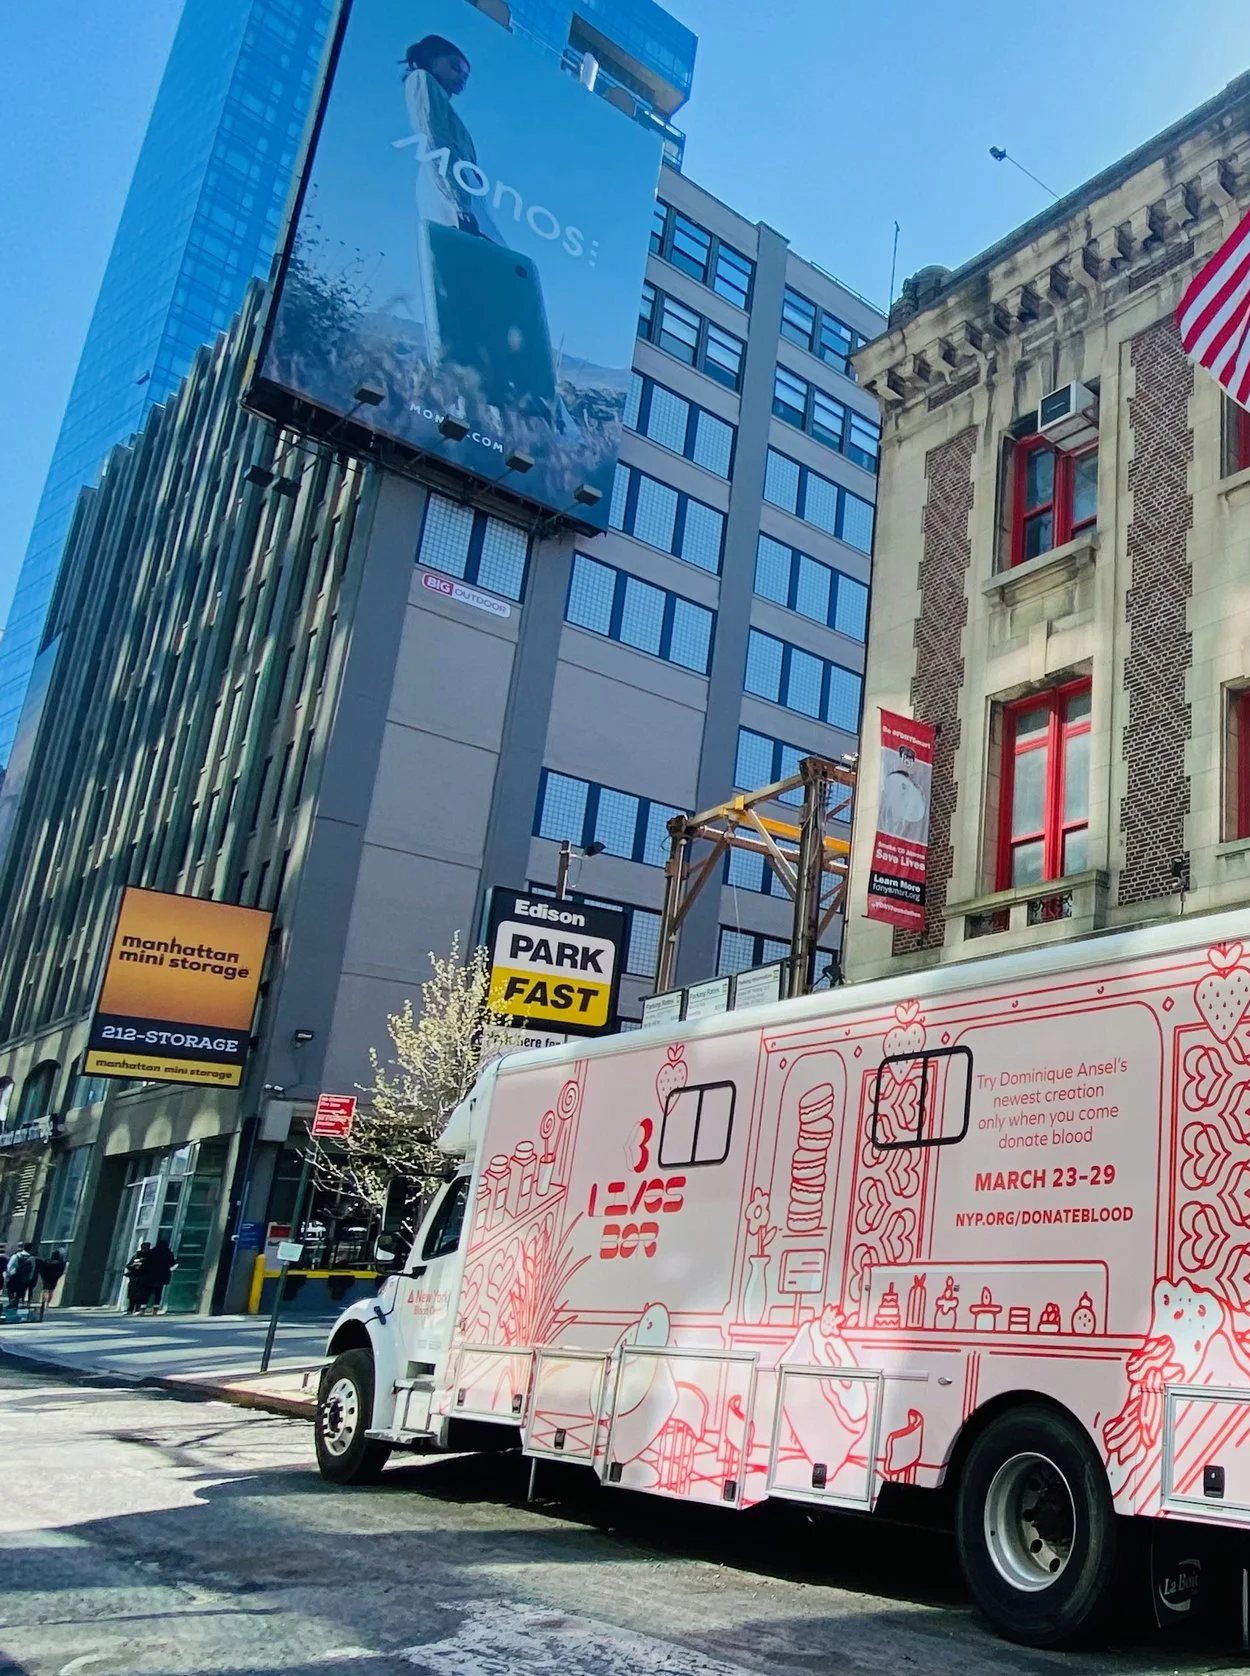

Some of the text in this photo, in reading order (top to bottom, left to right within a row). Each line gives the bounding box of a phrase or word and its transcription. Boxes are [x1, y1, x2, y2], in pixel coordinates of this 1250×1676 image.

[410, 403, 504, 453] MON.COM
[427, 576, 507, 612] BIG OUTDOOR
[875, 848, 926, 871] Save Lives
[873, 874, 921, 893] Learn More
[514, 899, 586, 927] Edison
[121, 935, 240, 964] manhattan
[509, 933, 605, 974] PARK
[118, 949, 250, 980] mini storage
[503, 976, 600, 1013] FAST
[102, 1025, 239, 1053] 212-STORAGE
[95, 1058, 233, 1080] manhattan mini storage
[977, 1057, 1129, 1092] Try Dominique Ansel's
[993, 1083, 1105, 1108] newest creation
[978, 1105, 1119, 1132] only when you come
[998, 1125, 1094, 1149] donate blood
[975, 1168, 1047, 1192] MARCH
[955, 1206, 1134, 1227] NYP.ORG/DONATEBLOOD
